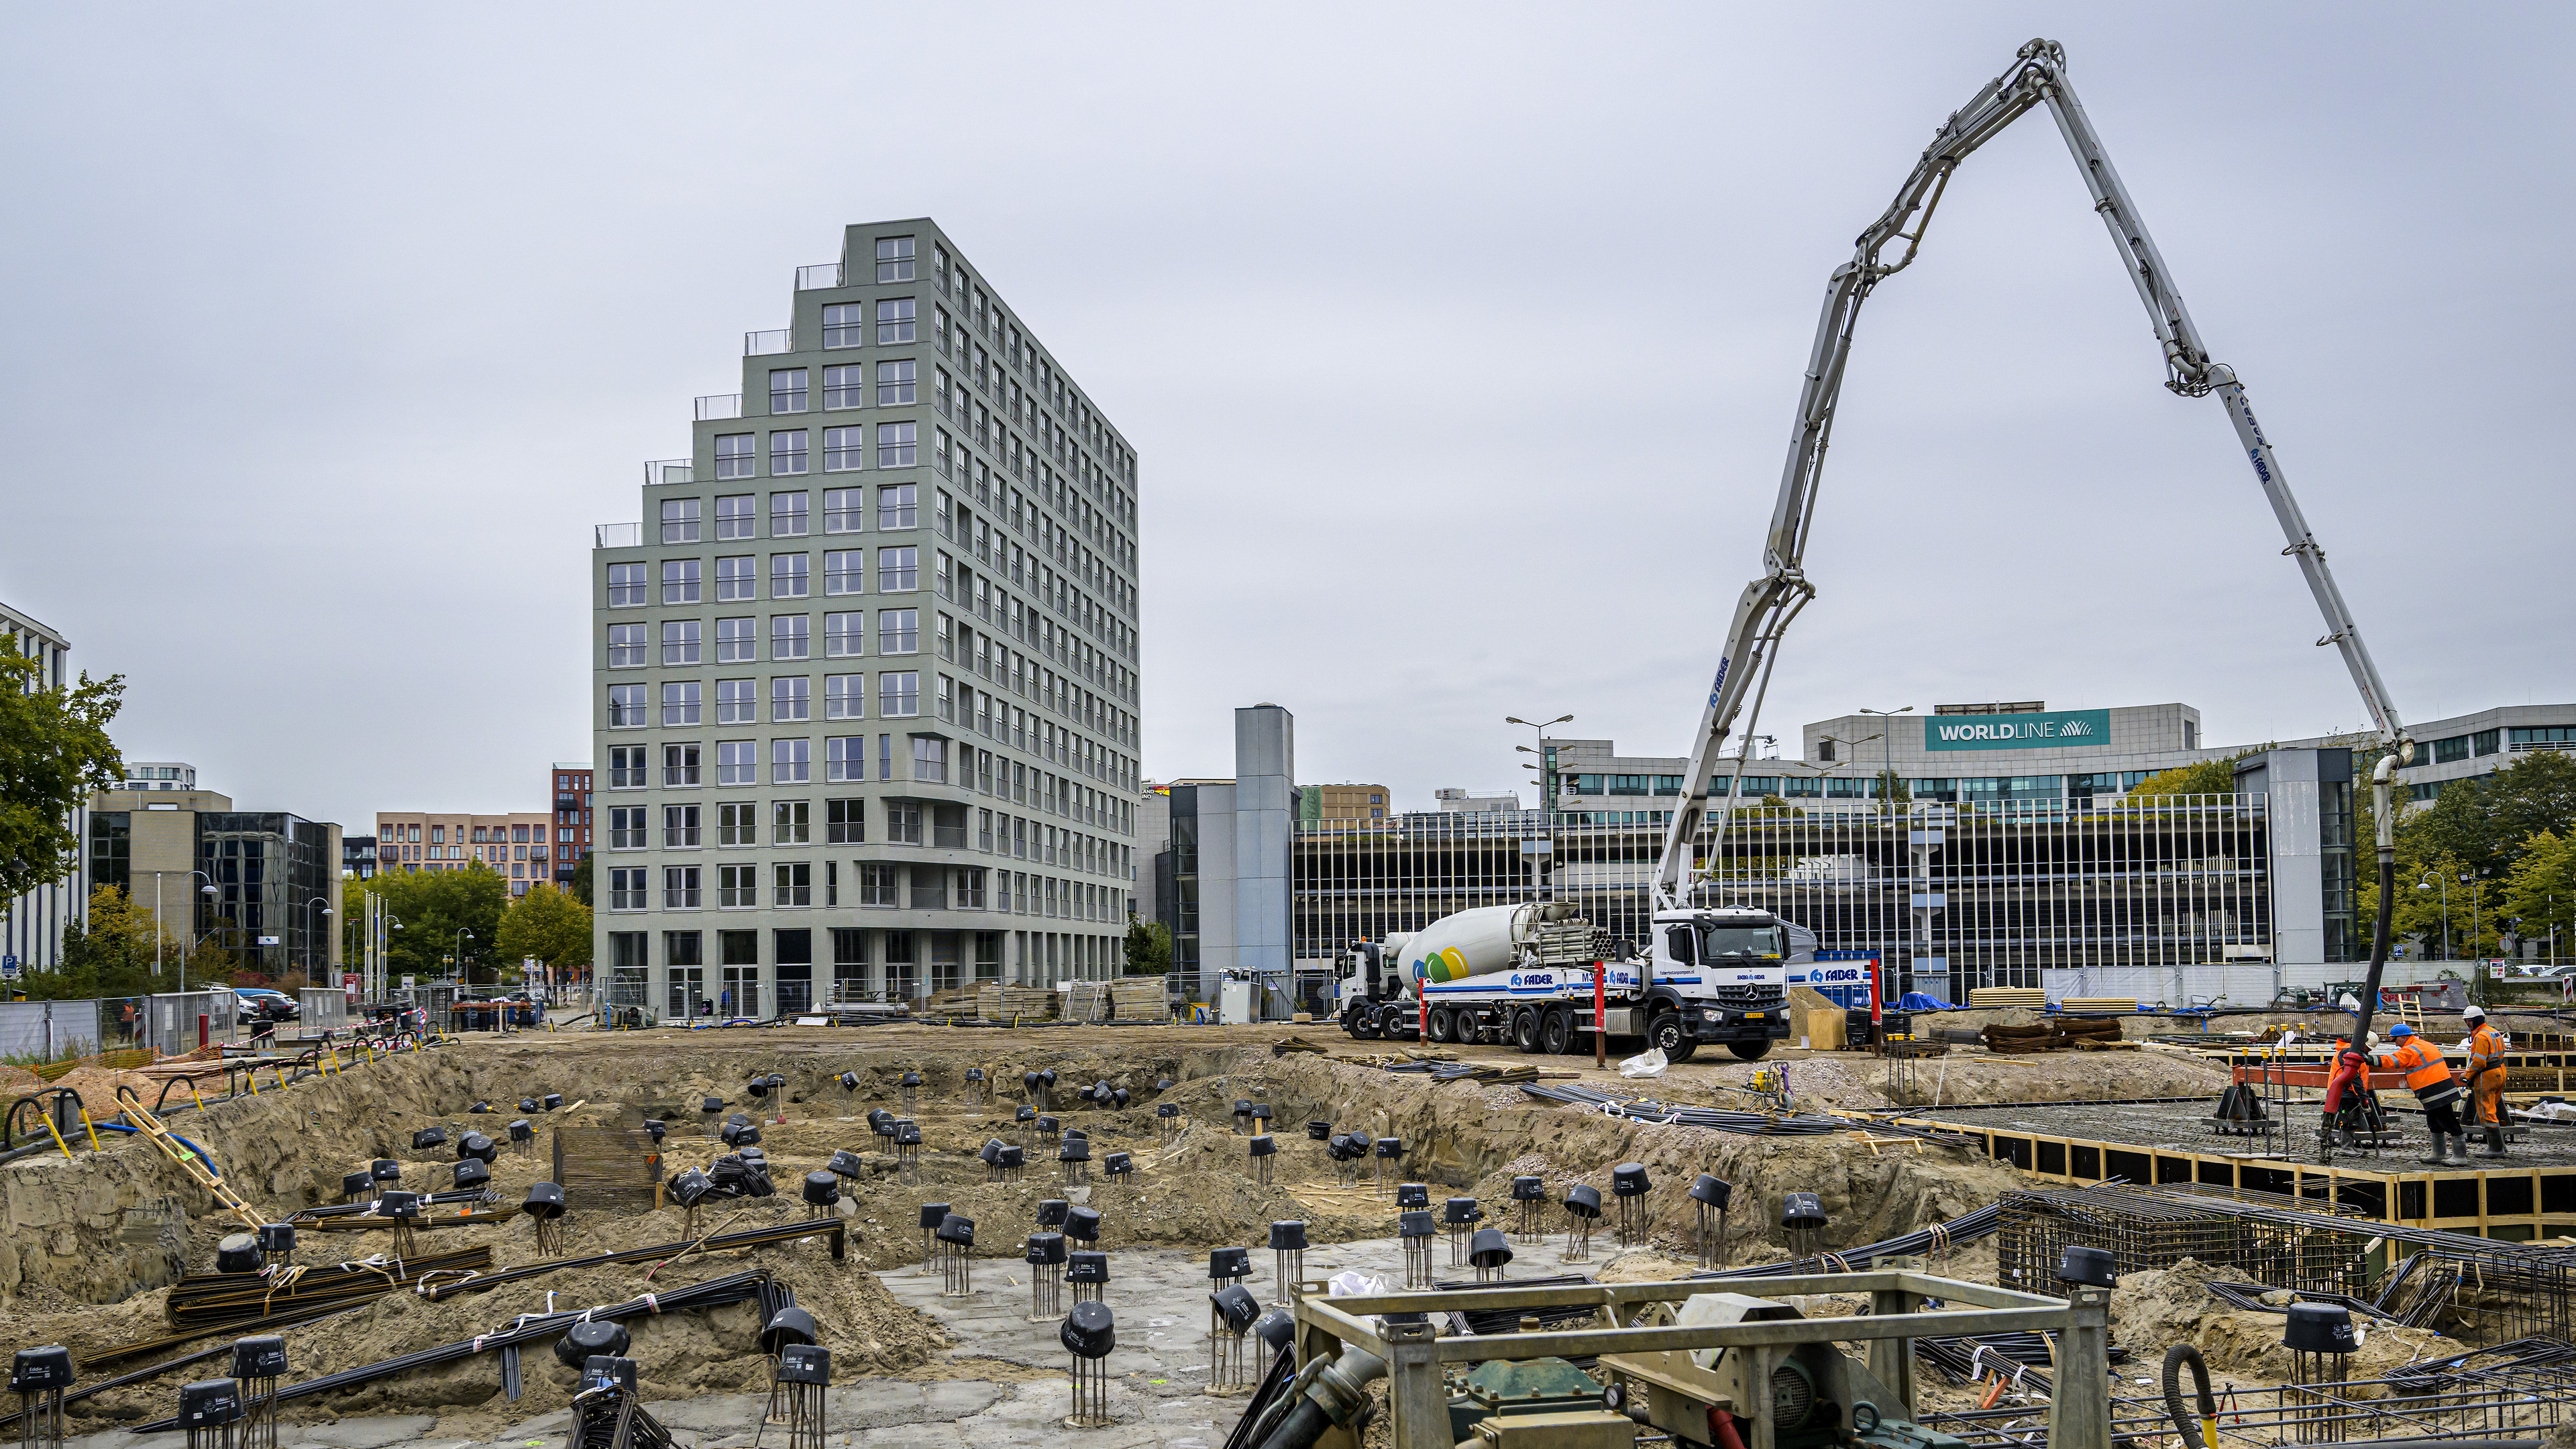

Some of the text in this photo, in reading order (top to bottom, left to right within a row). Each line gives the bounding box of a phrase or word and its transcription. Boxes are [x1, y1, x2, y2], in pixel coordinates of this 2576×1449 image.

[2240, 396, 2265, 445] FABER
[2254, 458, 2270, 484] FABER
[1714, 657, 1729, 693] FABER
[1939, 722, 2055, 741] WORLDLINE
[5, 957, 13, 966] P
[1524, 974, 1553, 985] FABER
[1582, 973, 1595, 982] M3
[1616, 972, 1629, 984] FABER
[1825, 969, 1858, 981] FABER
